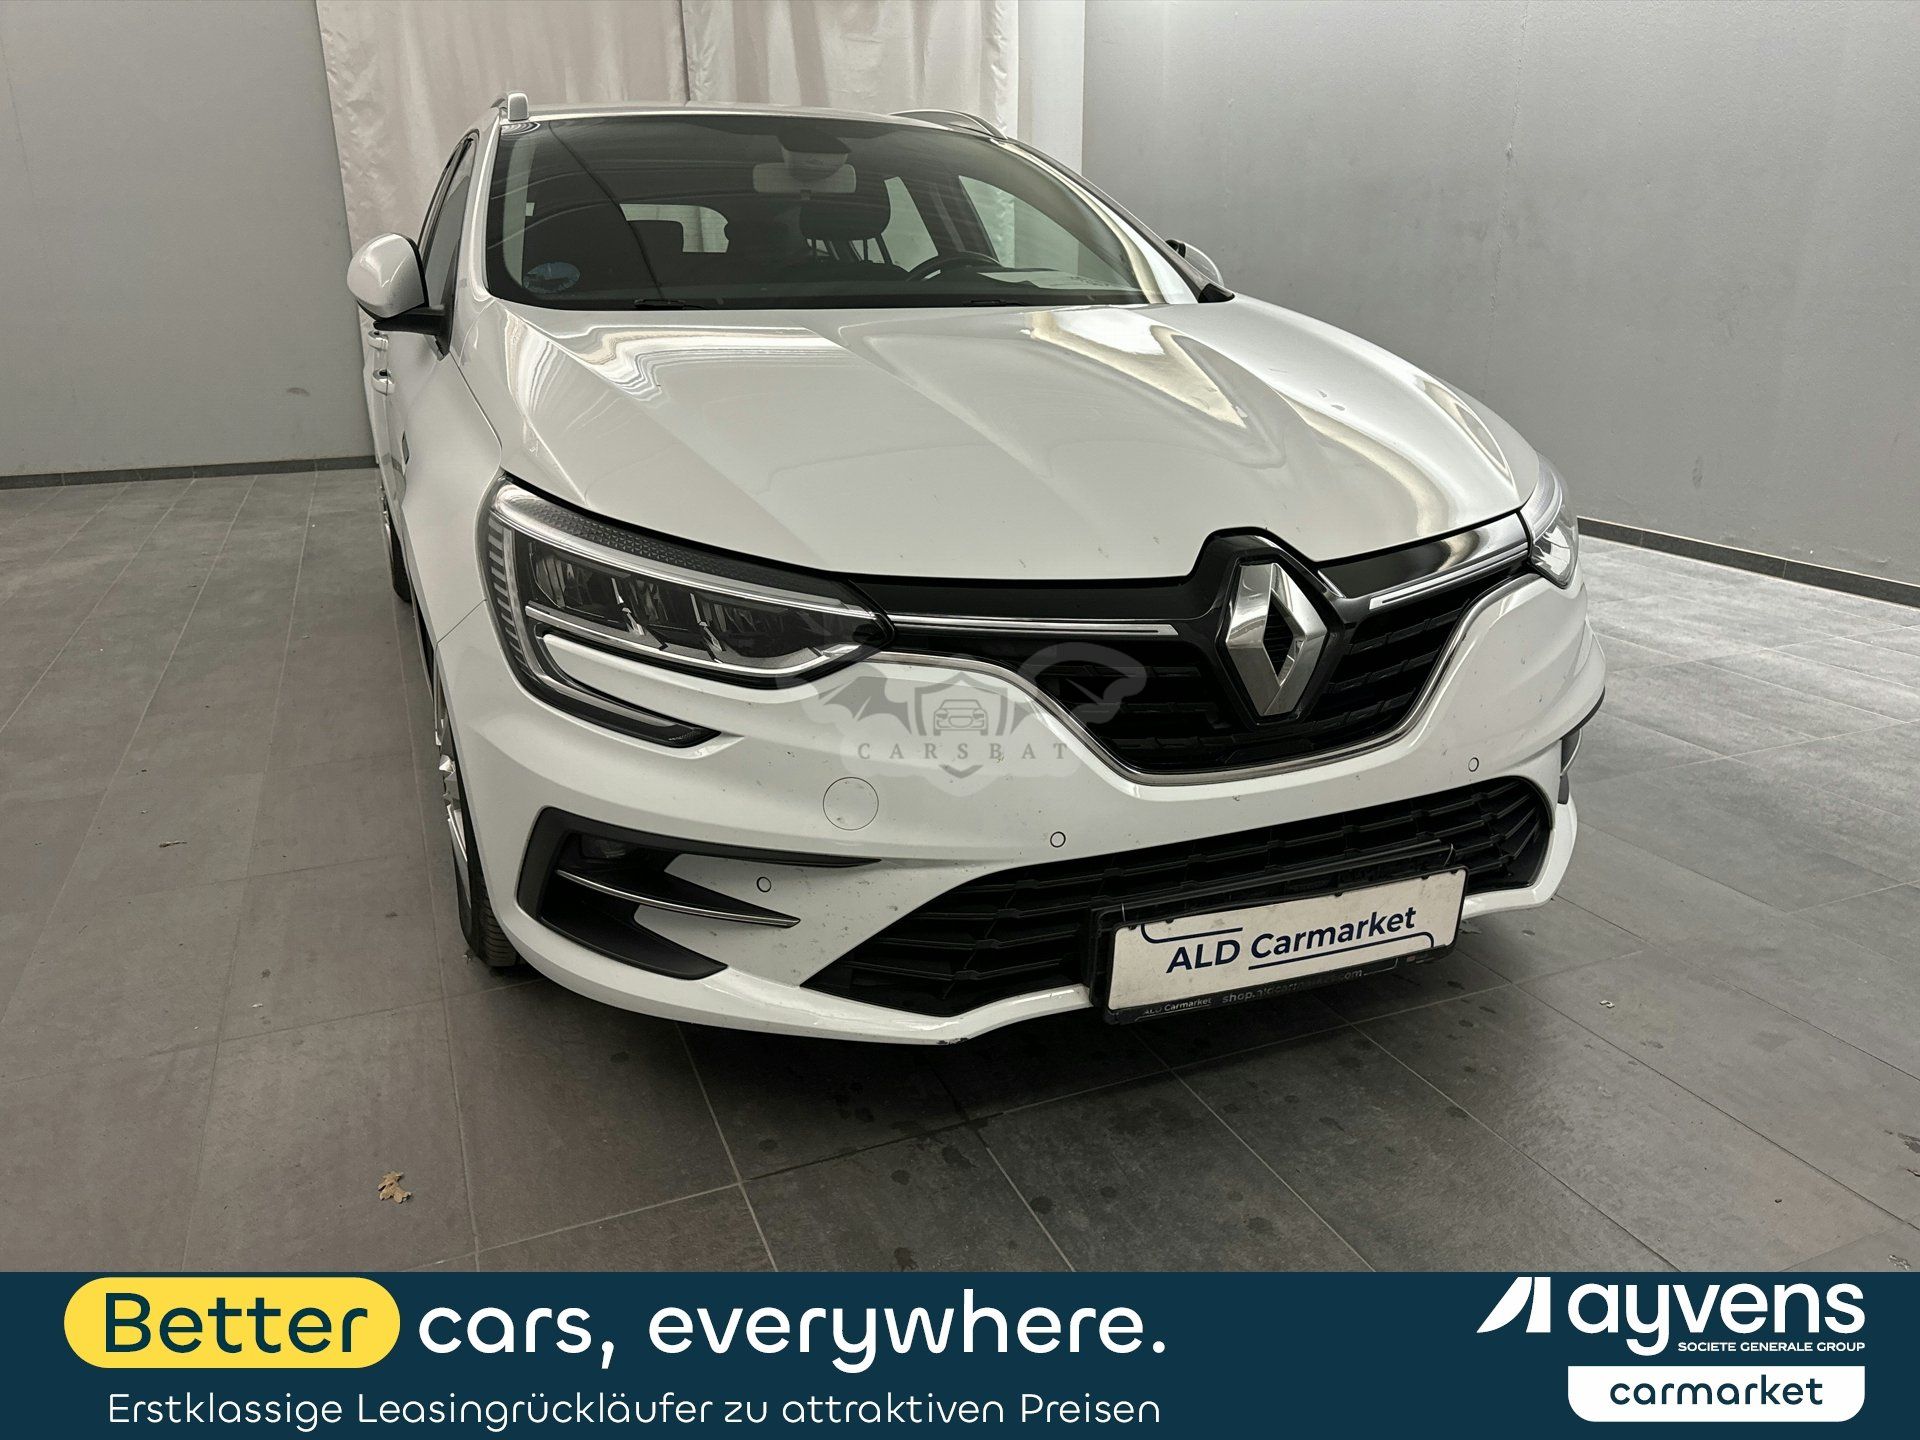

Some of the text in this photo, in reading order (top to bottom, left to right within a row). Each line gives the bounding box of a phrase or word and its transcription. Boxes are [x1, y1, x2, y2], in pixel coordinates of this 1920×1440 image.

[1165, 907, 1417, 974] ALD Carmarket
[1164, 997, 1212, 1013] Carmarket
